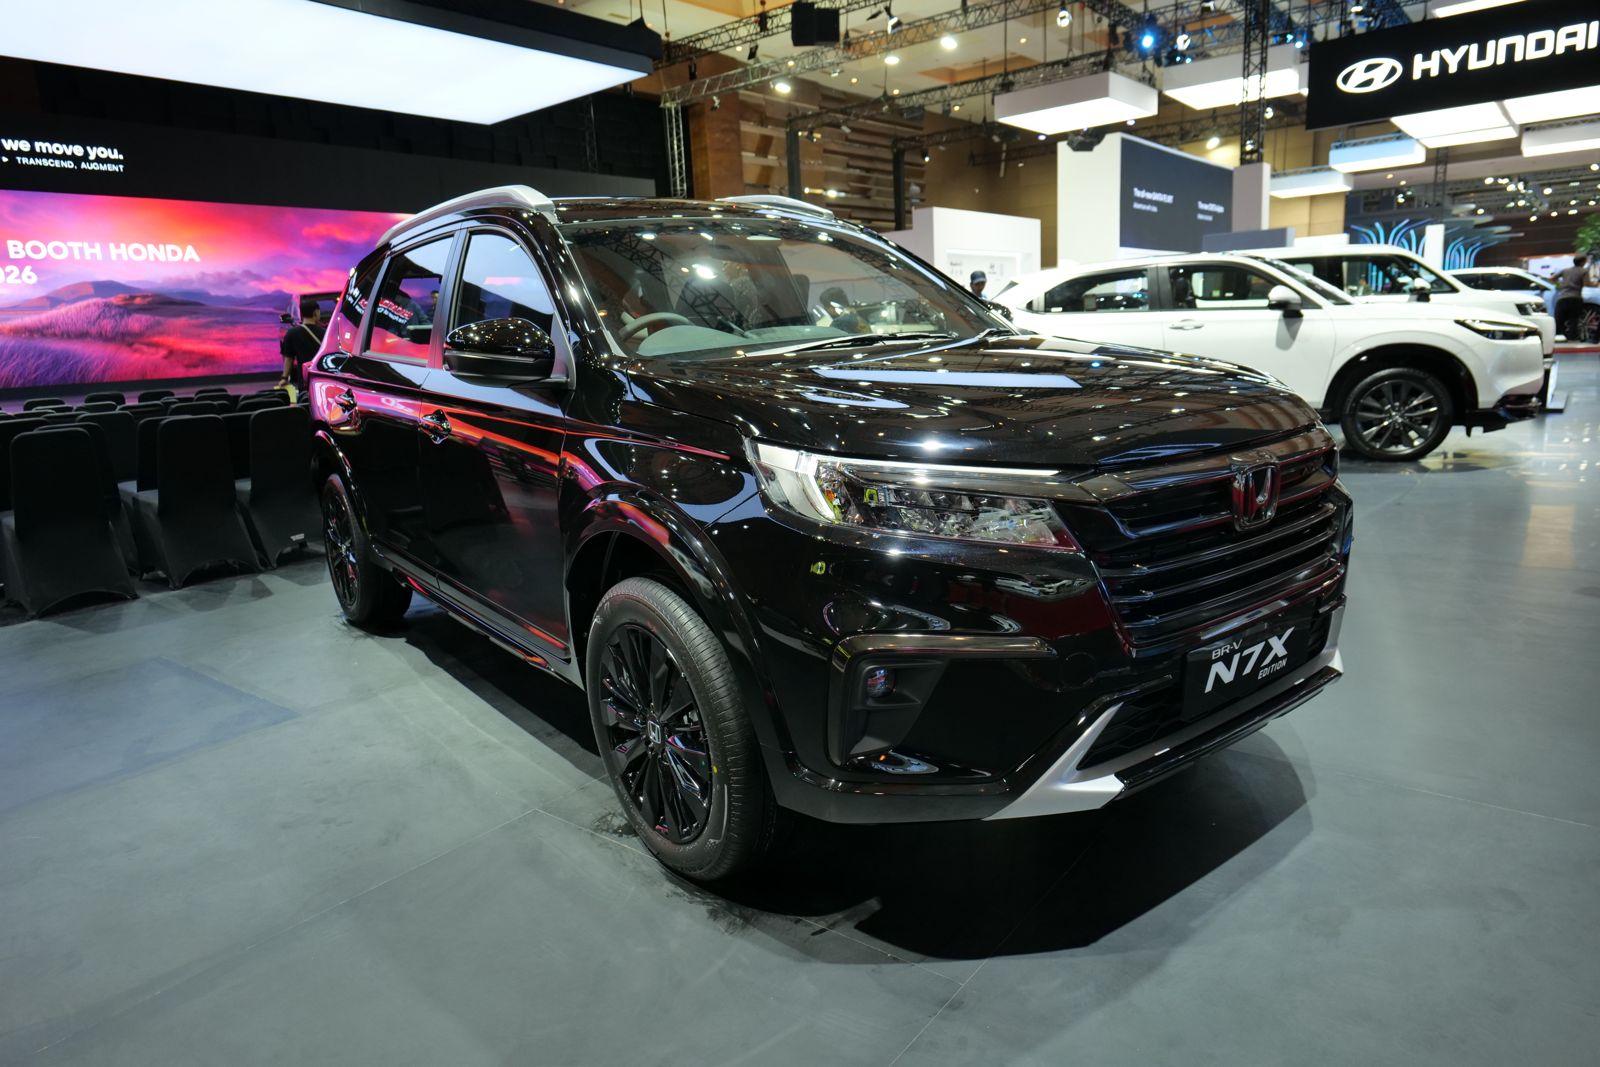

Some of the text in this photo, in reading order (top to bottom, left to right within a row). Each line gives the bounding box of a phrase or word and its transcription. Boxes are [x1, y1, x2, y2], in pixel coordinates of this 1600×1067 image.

[1412, 20, 1600, 80] HYUNDAI
[1, 138, 124, 160] we move you.
[16, 156, 124, 173] TRANSCEND, AUGMENT
[7, 239, 200, 262] BOOTH HONDA
[1204, 626, 1295, 694] N7X
[1211, 639, 1243, 660] BR-V
[1257, 657, 1288, 680] EDITION
